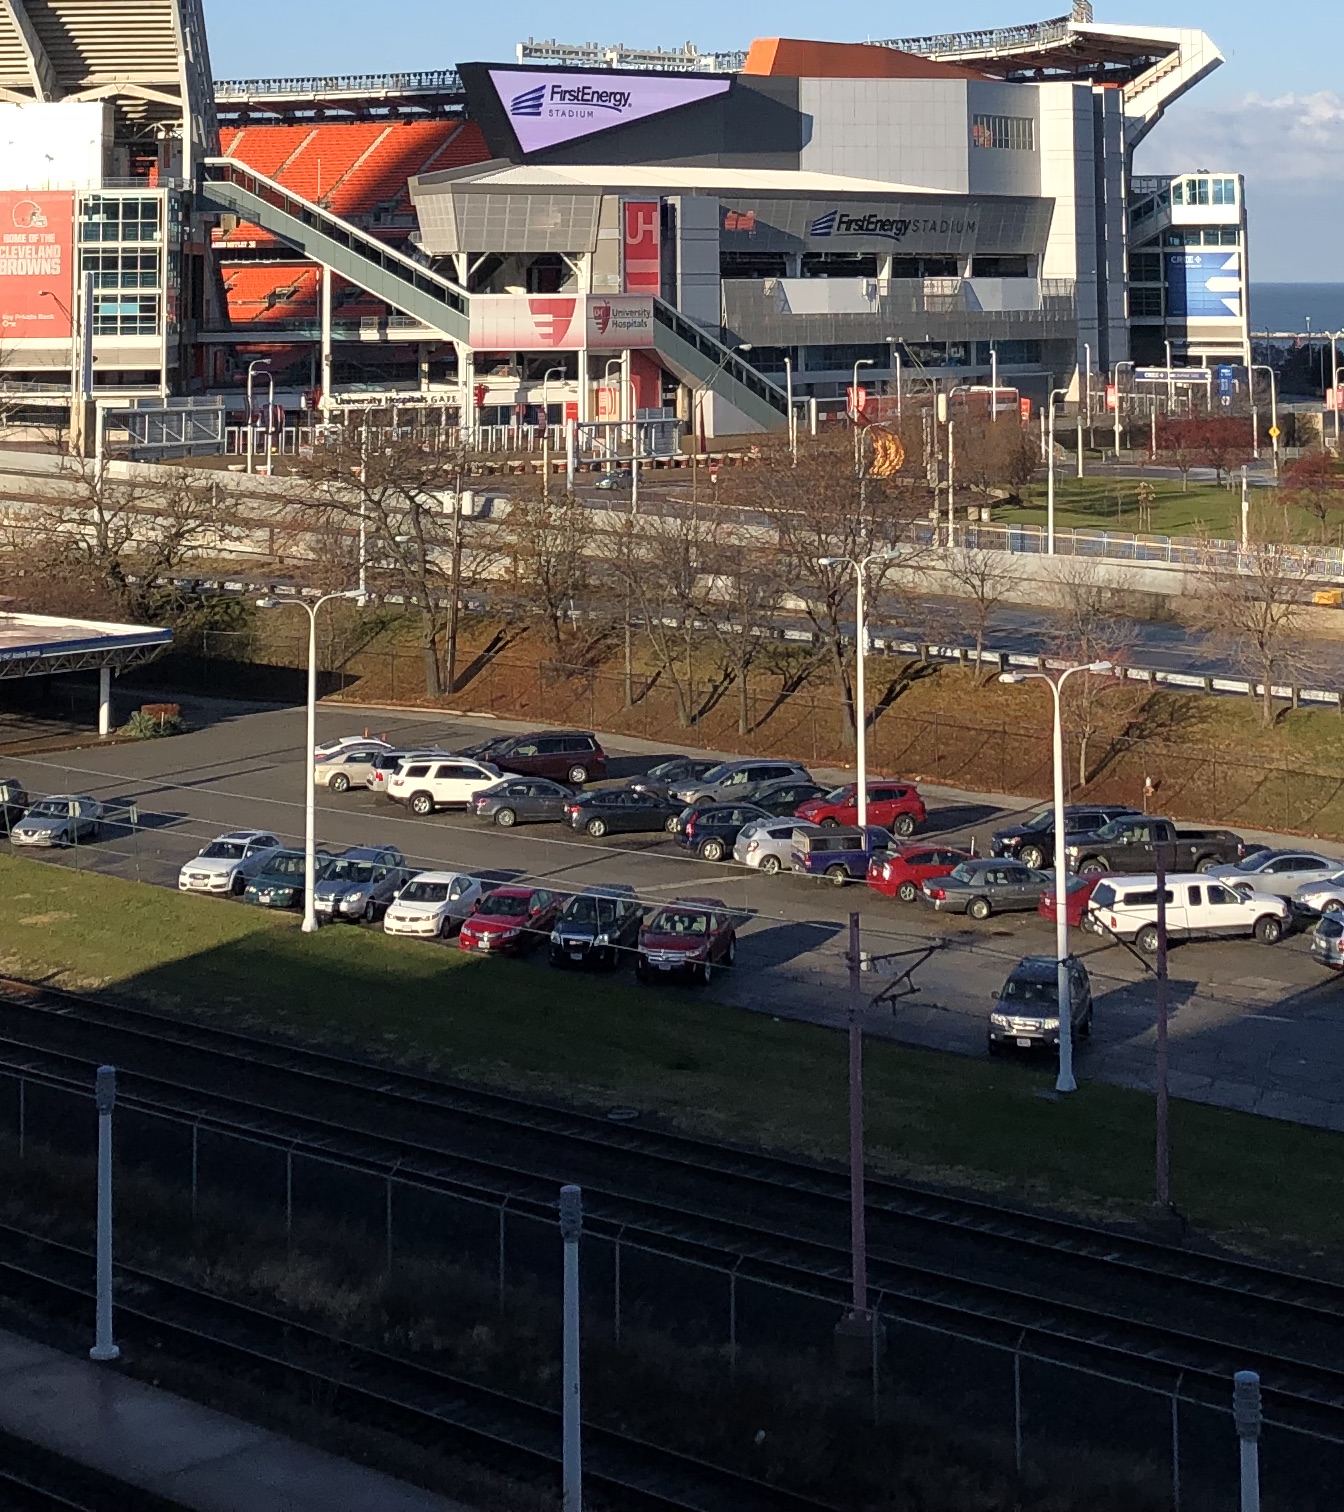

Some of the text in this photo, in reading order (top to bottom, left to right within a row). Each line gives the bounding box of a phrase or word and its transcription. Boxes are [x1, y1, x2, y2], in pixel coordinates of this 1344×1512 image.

[550, 85, 631, 108] FirstEnergy
[548, 109, 594, 118] STADIUM
[837, 214, 976, 236] FirstEnergy STADIUM
[3, 234, 55, 244] HOME OF THE
[612, 309, 651, 319] University
[612, 319, 648, 330] Hospitals
[336, 396, 382, 408] University
[385, 395, 428, 405] Hospitals
